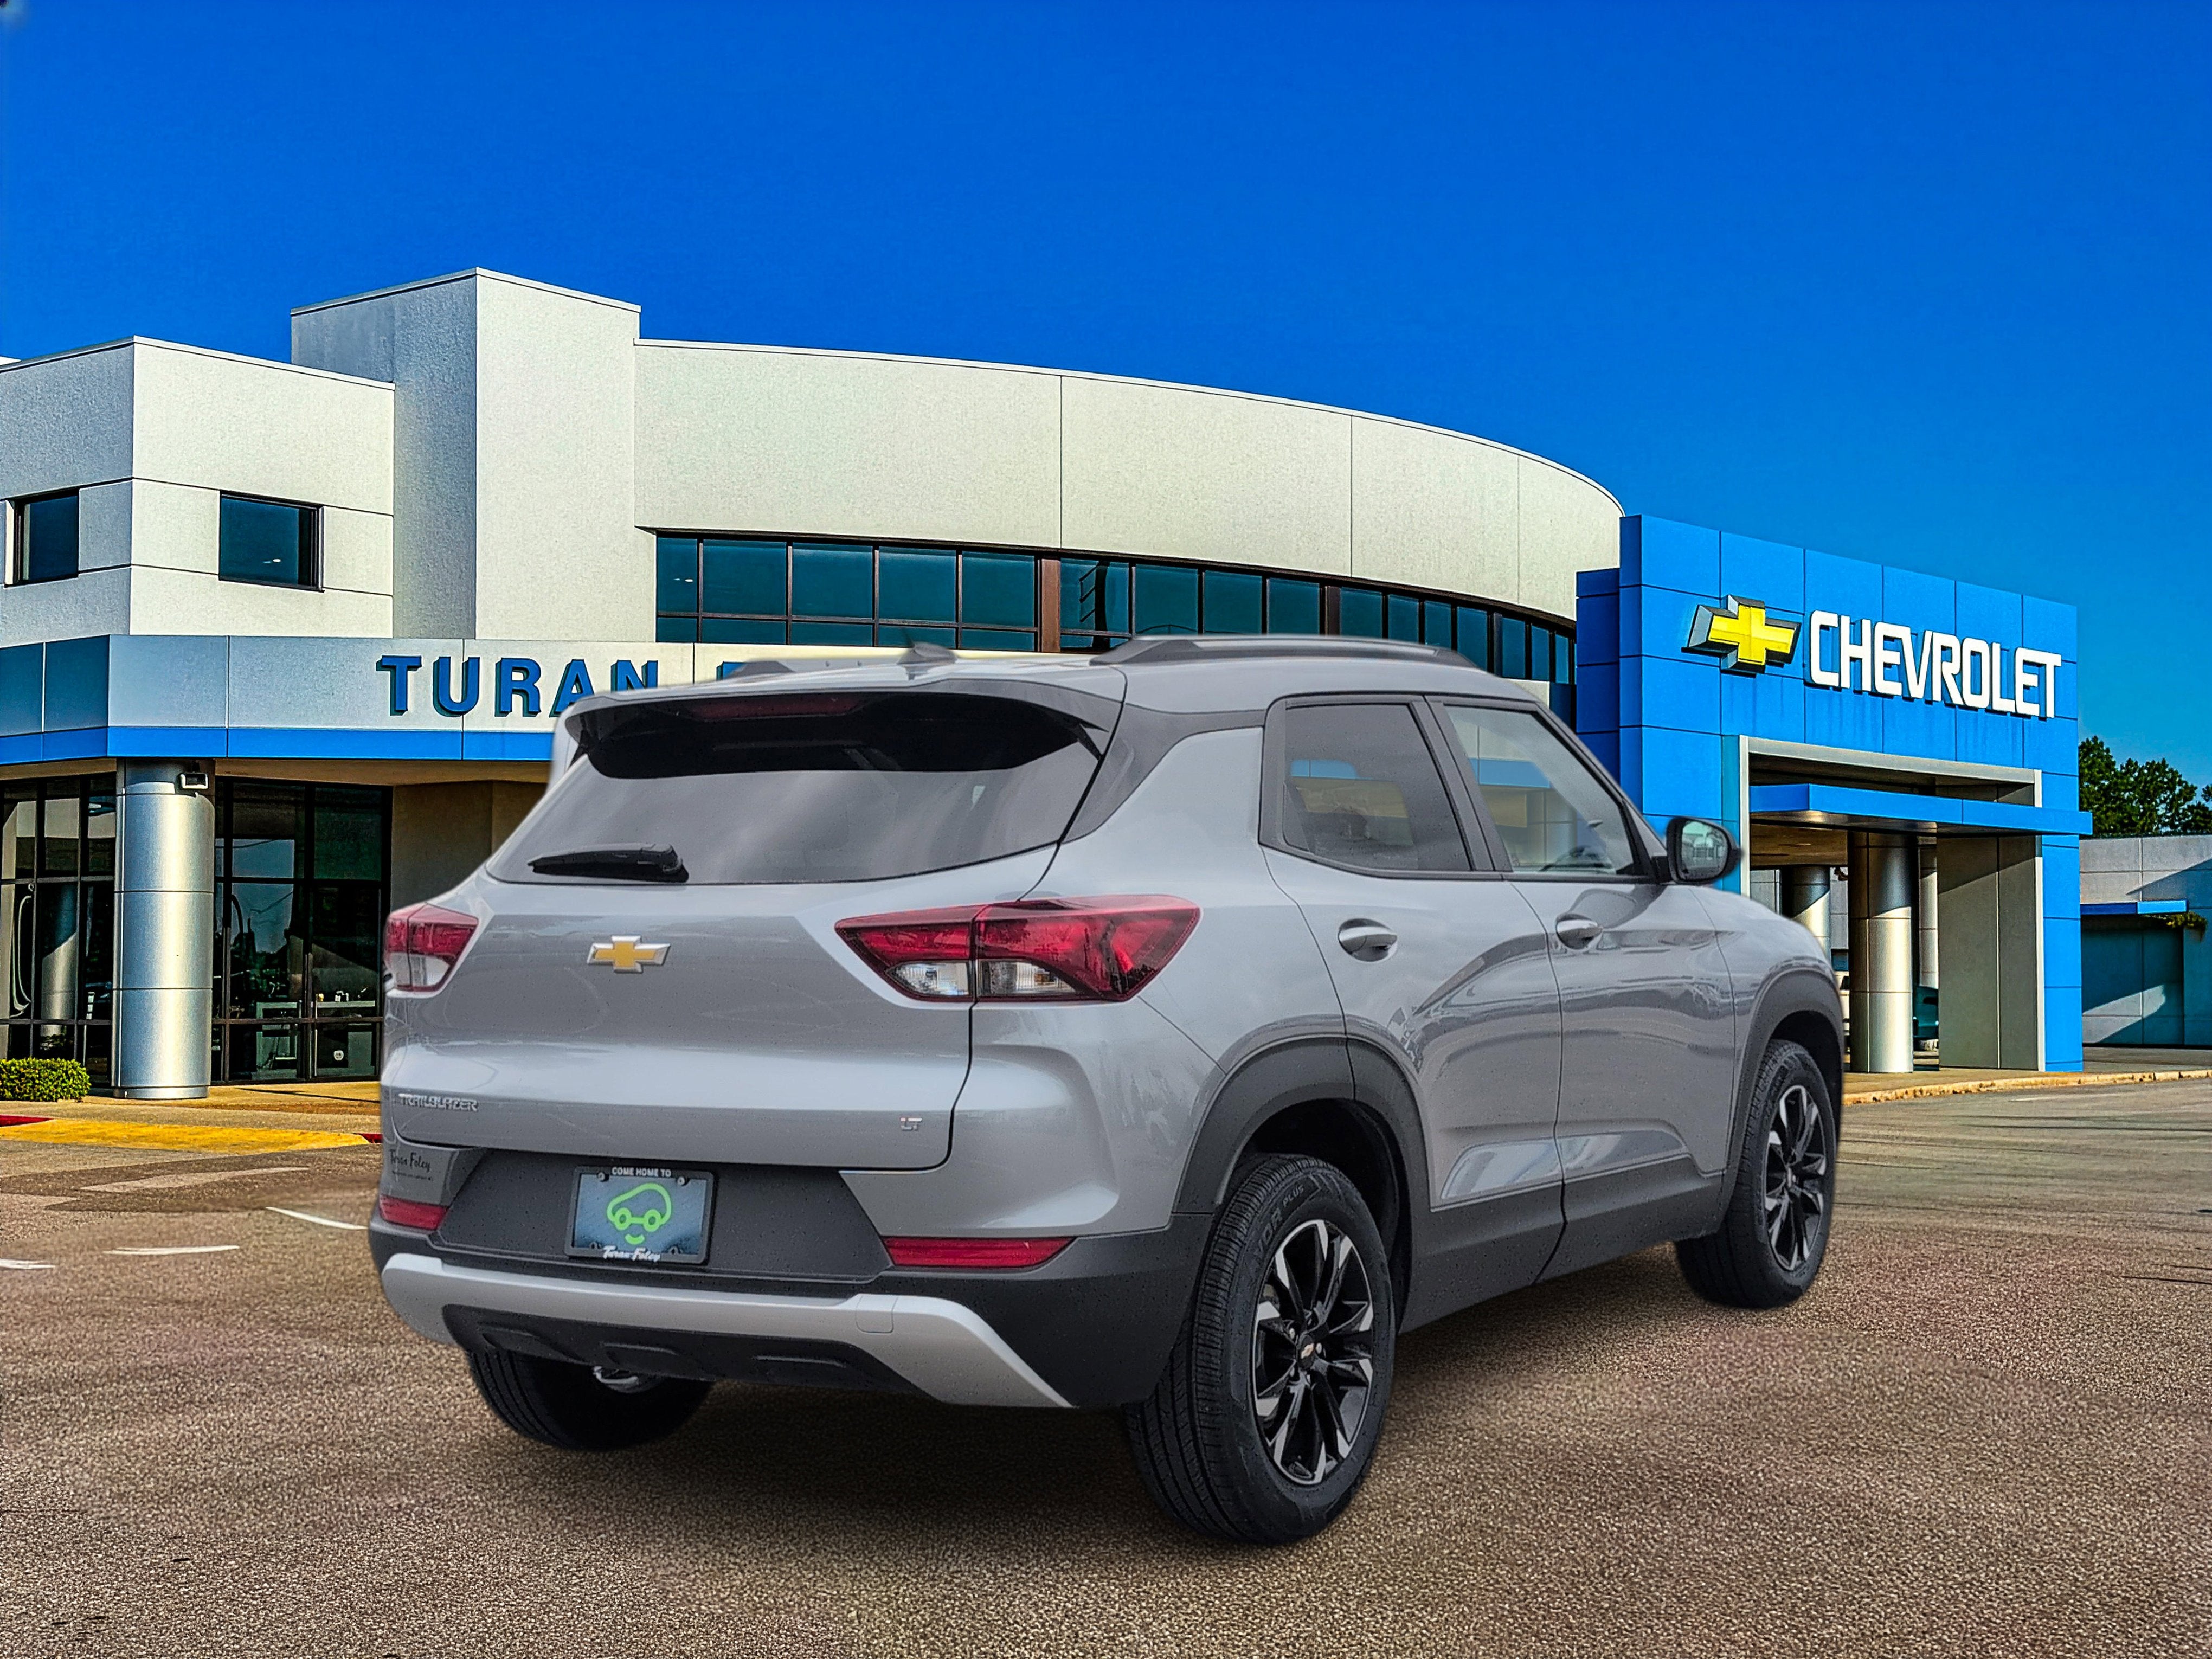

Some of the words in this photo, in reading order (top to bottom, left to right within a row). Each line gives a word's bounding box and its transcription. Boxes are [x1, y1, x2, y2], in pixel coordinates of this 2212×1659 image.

[1808, 609, 2062, 719] CHEVROLET
[376, 655, 659, 717] TURAN
[901, 1117, 923, 1131] LT
[612, 1167, 634, 1176] COME
[635, 1168, 659, 1177] HOME
[660, 1169, 672, 1177] TO
